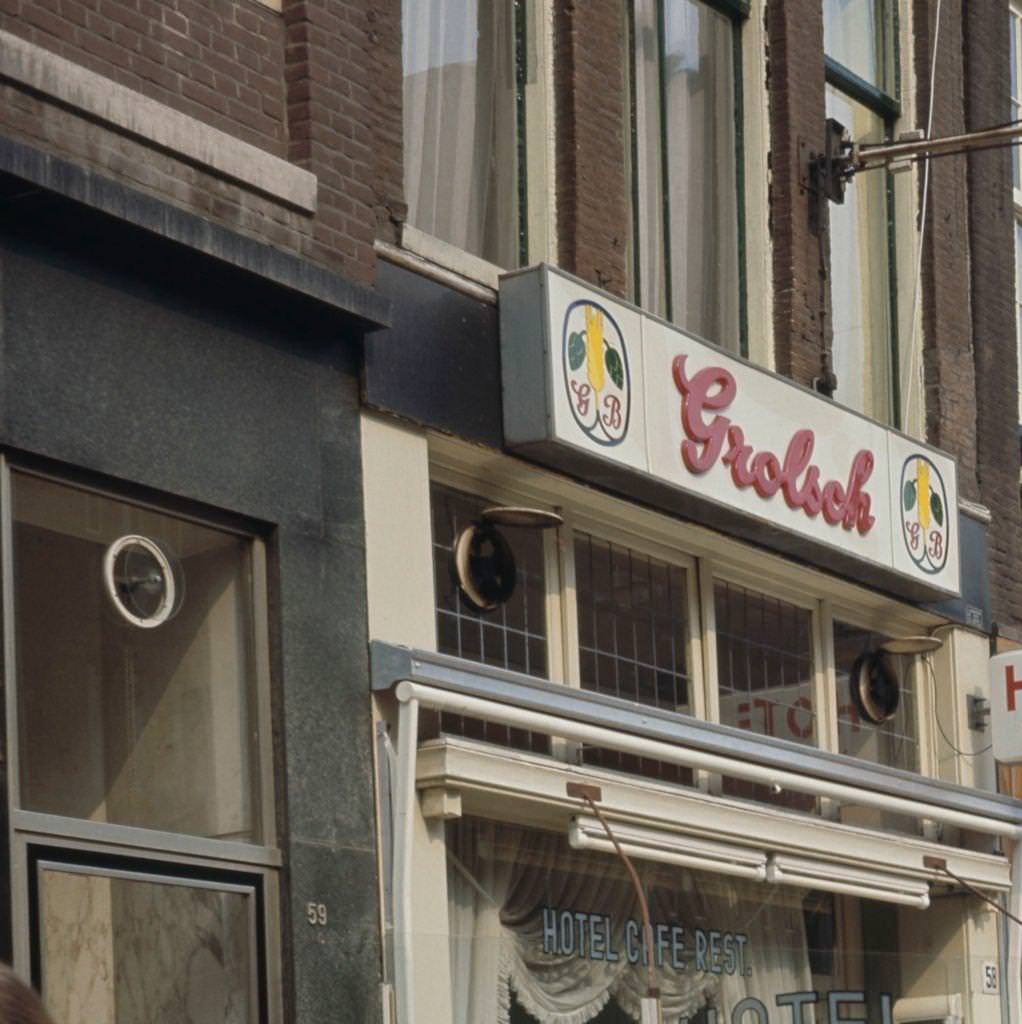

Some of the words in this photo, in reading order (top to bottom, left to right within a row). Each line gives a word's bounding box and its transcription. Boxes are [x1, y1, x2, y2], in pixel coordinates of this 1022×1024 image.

[672, 353, 876, 536] Grolsch
[306, 901, 328, 926] 59
[543, 906, 620, 962] HOTEL
[694, 928, 753, 977] REST.
[984, 964, 998, 990] 58
